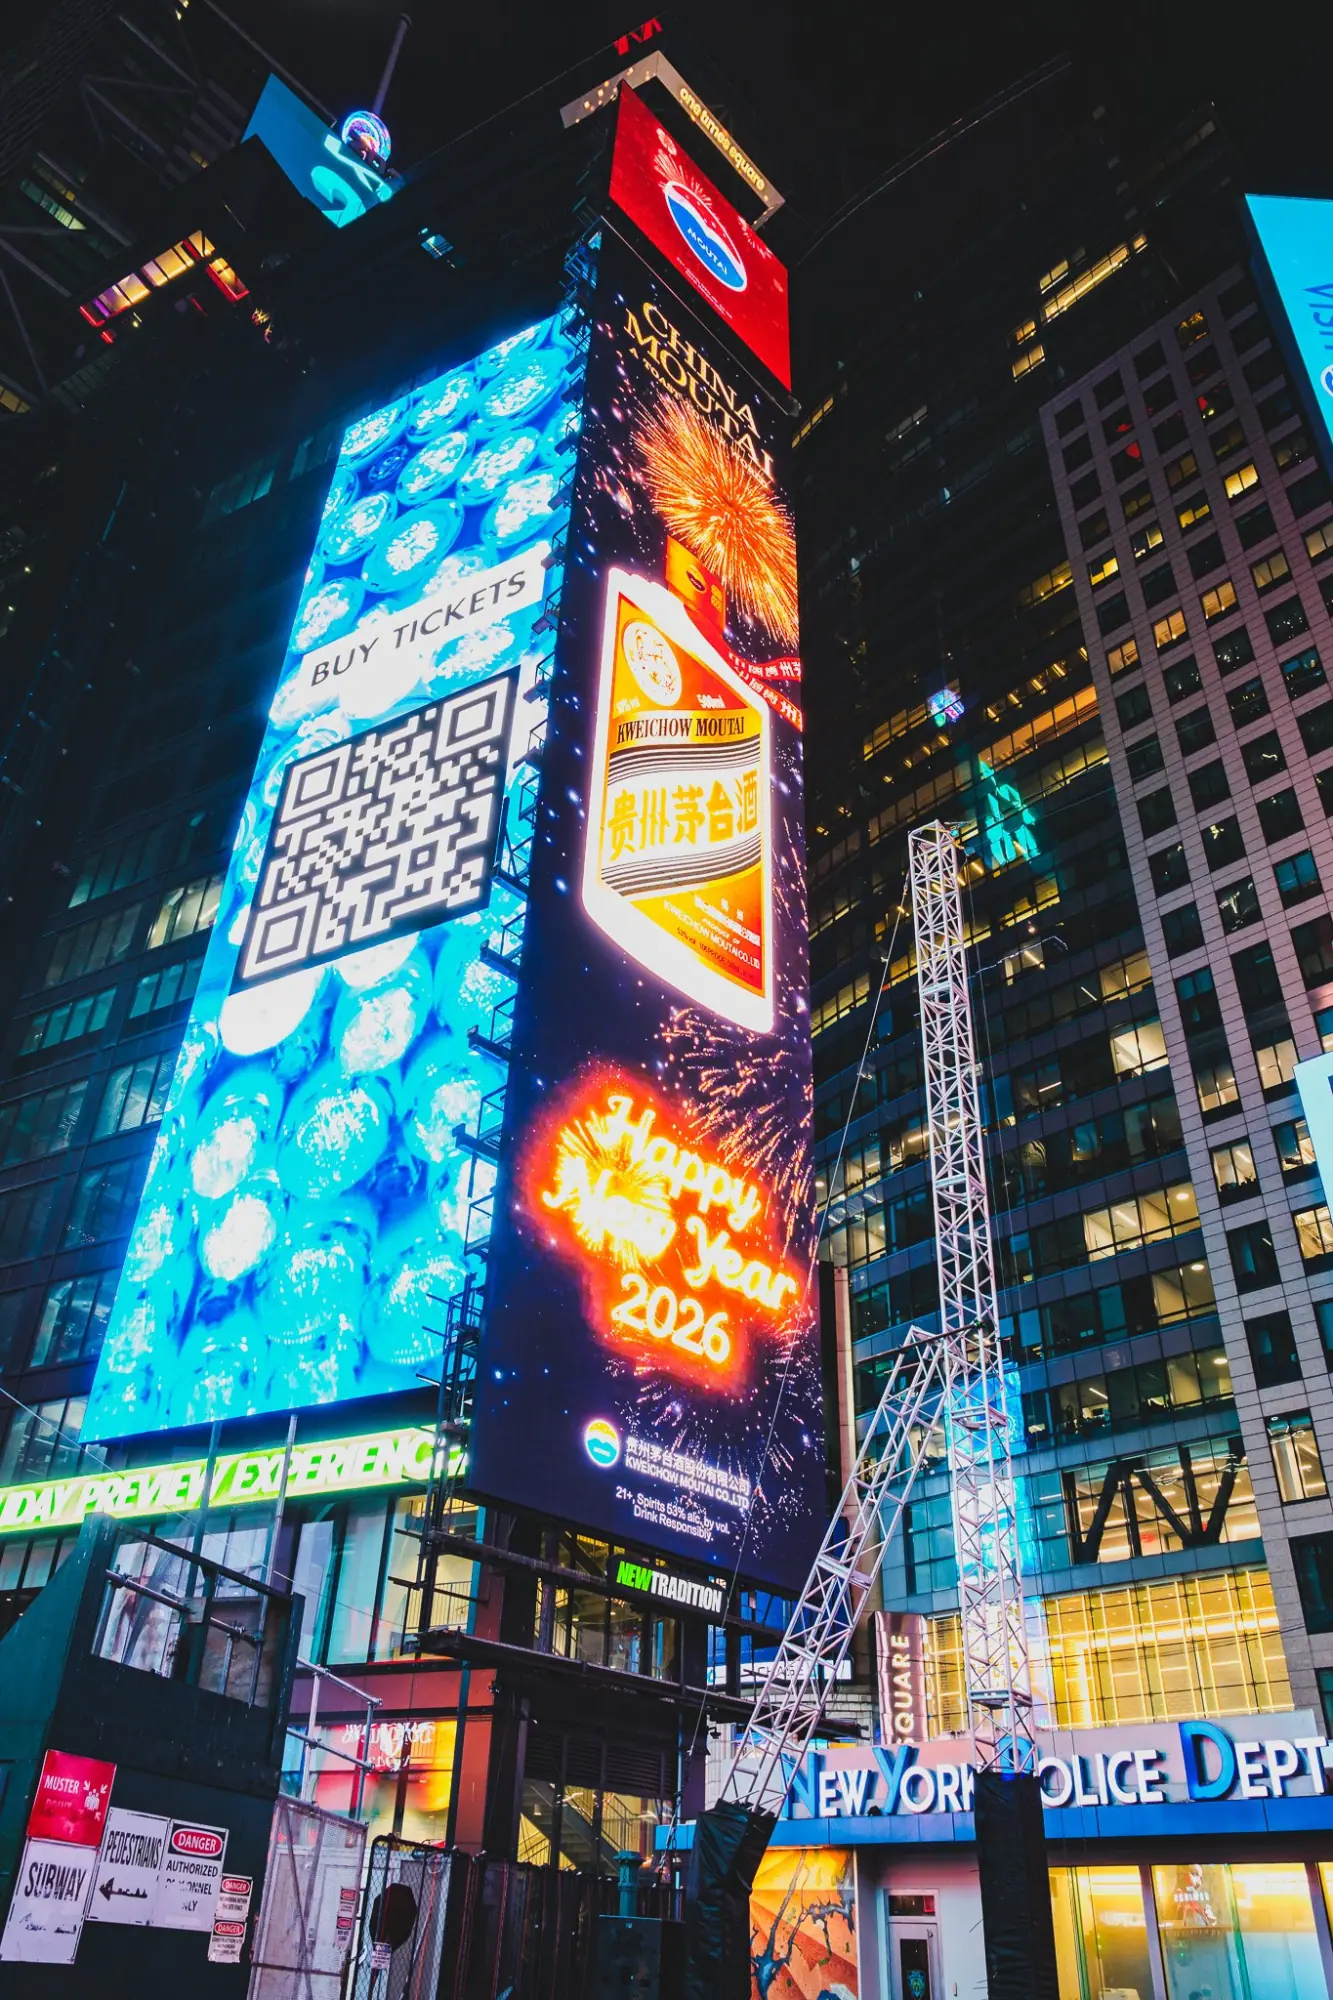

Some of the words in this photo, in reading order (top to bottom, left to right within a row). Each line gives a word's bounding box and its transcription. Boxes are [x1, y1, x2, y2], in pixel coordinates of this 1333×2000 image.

[679, 87, 702, 117] one
[700, 109, 731, 150] times
[728, 146, 765, 191] square
[687, 227, 728, 275] MOUTAI
[642, 301, 761, 439] CHINA
[623, 308, 775, 483] MOUTAI
[311, 637, 379, 687] BUY
[393, 570, 526, 649] TICKETS
[617, 718, 693, 744] KWEICHOW
[695, 716, 745, 737] MOUTAI
[607, 768, 758, 862] 贵州茅台酒
[594, 1095, 762, 1232] Happy
[684, 1216, 797, 1310] Year
[611, 1273, 730, 1364] 2026
[0, 1482, 83, 1526] DAY
[75, 1460, 238, 1518] PREVIEW
[625, 1456, 679, 1485] KWEICHOW
[680, 1476, 715, 1498] MOUTAI
[633, 1505, 658, 1523] Drink
[637, 1493, 666, 1514] Spirits
[666, 1503, 686, 1520] 53%
[703, 1515, 715, 1531] by
[44, 1774, 80, 1794] MUSTER
[781, 1751, 873, 1819] NEW
[1178, 1720, 1327, 1800] DEPT
[103, 1829, 163, 1870] PEDESTRIANS
[177, 1833, 217, 1853] DANGER
[24, 1861, 87, 1902] SUBWAY
[165, 1859, 218, 1877] AUTHORIZED
[225, 1880, 247, 1892] DANGER
[217, 1923, 240, 1935] DANGER
